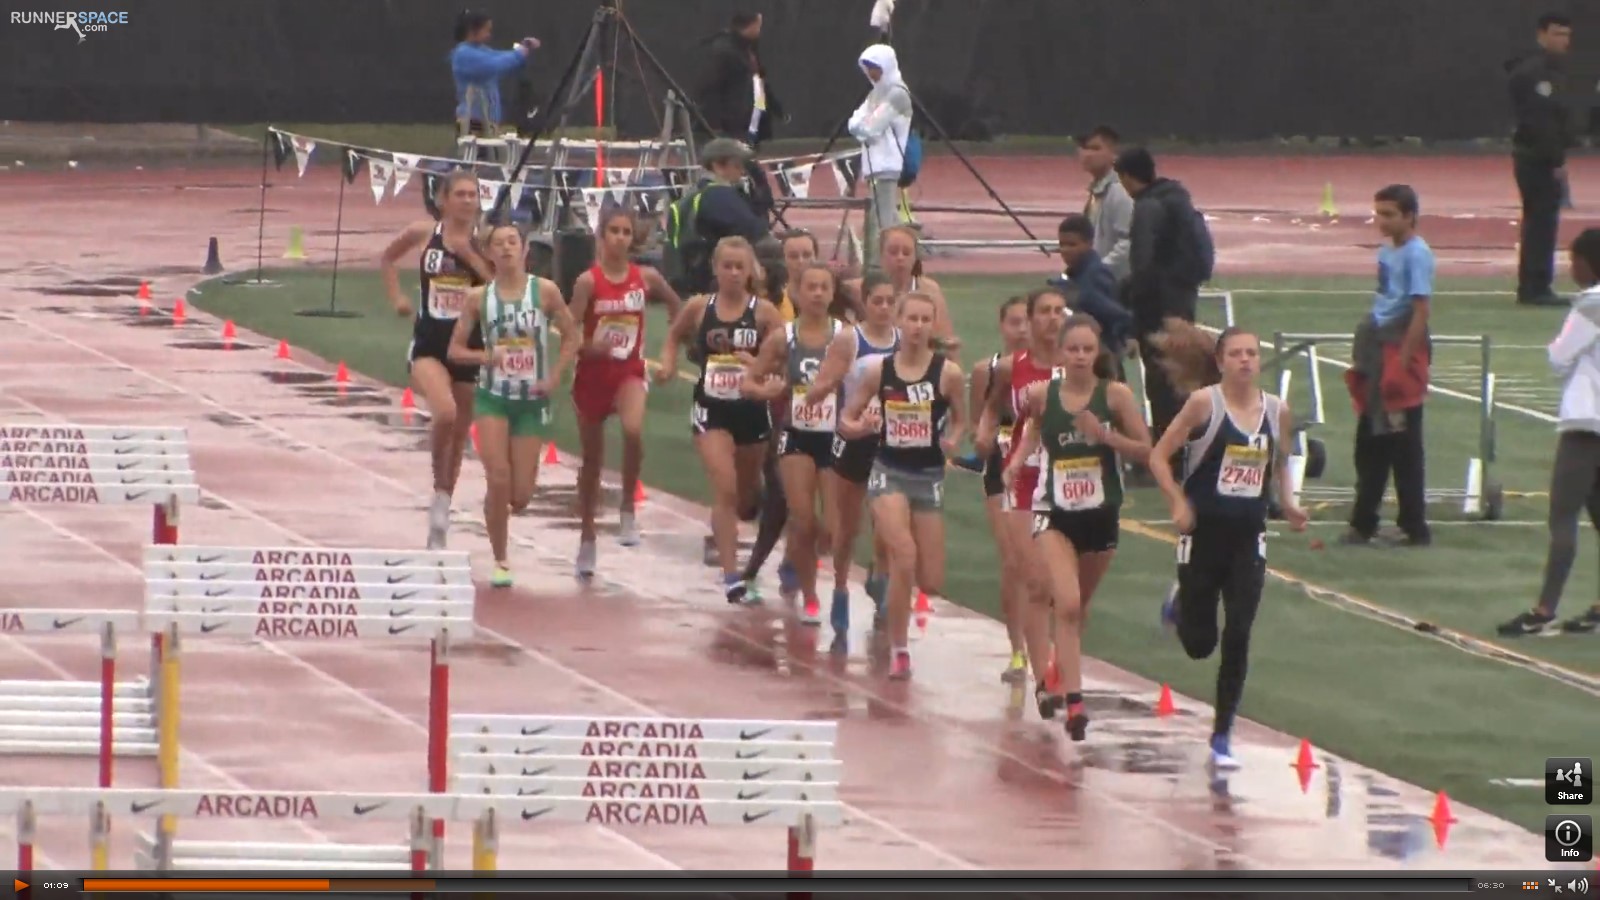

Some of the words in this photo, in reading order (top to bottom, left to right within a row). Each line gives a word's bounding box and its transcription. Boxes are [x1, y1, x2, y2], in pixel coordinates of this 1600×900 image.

[739, 329, 755, 347] 10
[911, 383, 930, 405] 15
[1222, 467, 1261, 485] 2740
[9, 486, 100, 503] ARCADIA
[1063, 481, 1096, 499] 600
[255, 618, 359, 637] ARCADIA
[586, 721, 704, 739] ARCADIA
[581, 741, 698, 758] ARCADIA
[587, 760, 707, 779] ARCADIA
[582, 782, 700, 799] ARCADIA
[195, 794, 319, 818] ARCADIA
[585, 802, 708, 825] ARCADIA
